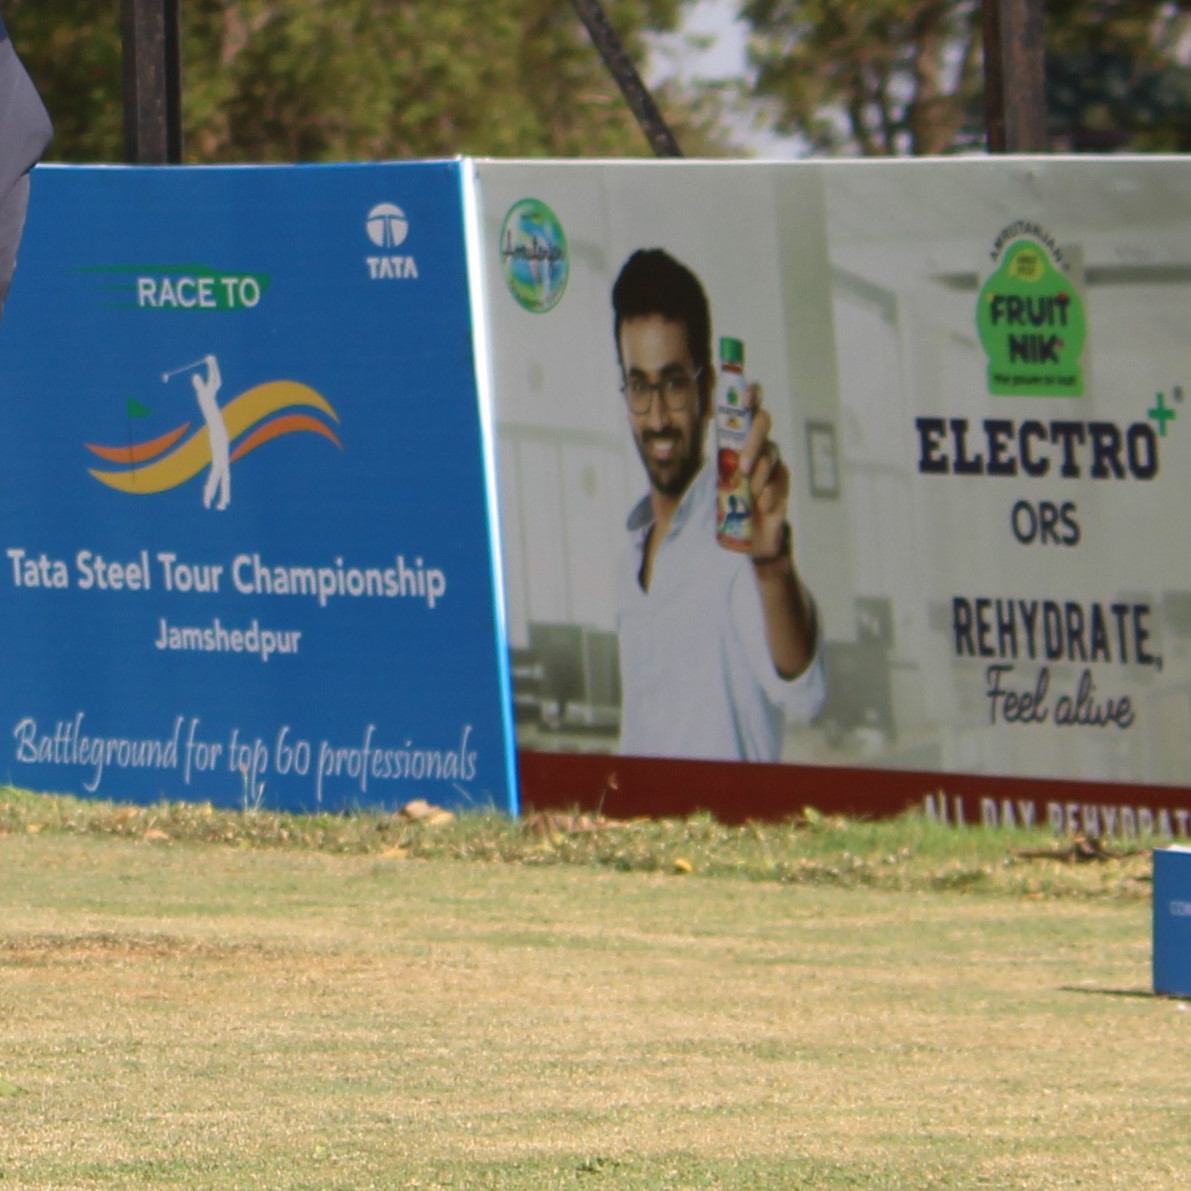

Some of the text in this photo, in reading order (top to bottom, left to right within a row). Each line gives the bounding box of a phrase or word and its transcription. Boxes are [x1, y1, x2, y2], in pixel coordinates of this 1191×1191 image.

[366, 256, 419, 280] TATA
[137, 277, 261, 308] RACE TO
[989, 293, 1070, 327] FRUIT
[1009, 333, 1060, 364] NIK
[1011, 500, 1081, 547] ORS
[8, 549, 446, 607] Tata Steel Tour Championship
[155, 619, 302, 661] Jamshedpur
[952, 596, 1162, 672] REHYDRATE,
[986, 664, 1136, 729] Feel alive
[14, 711, 477, 802] Battleground for top 60 professionals
